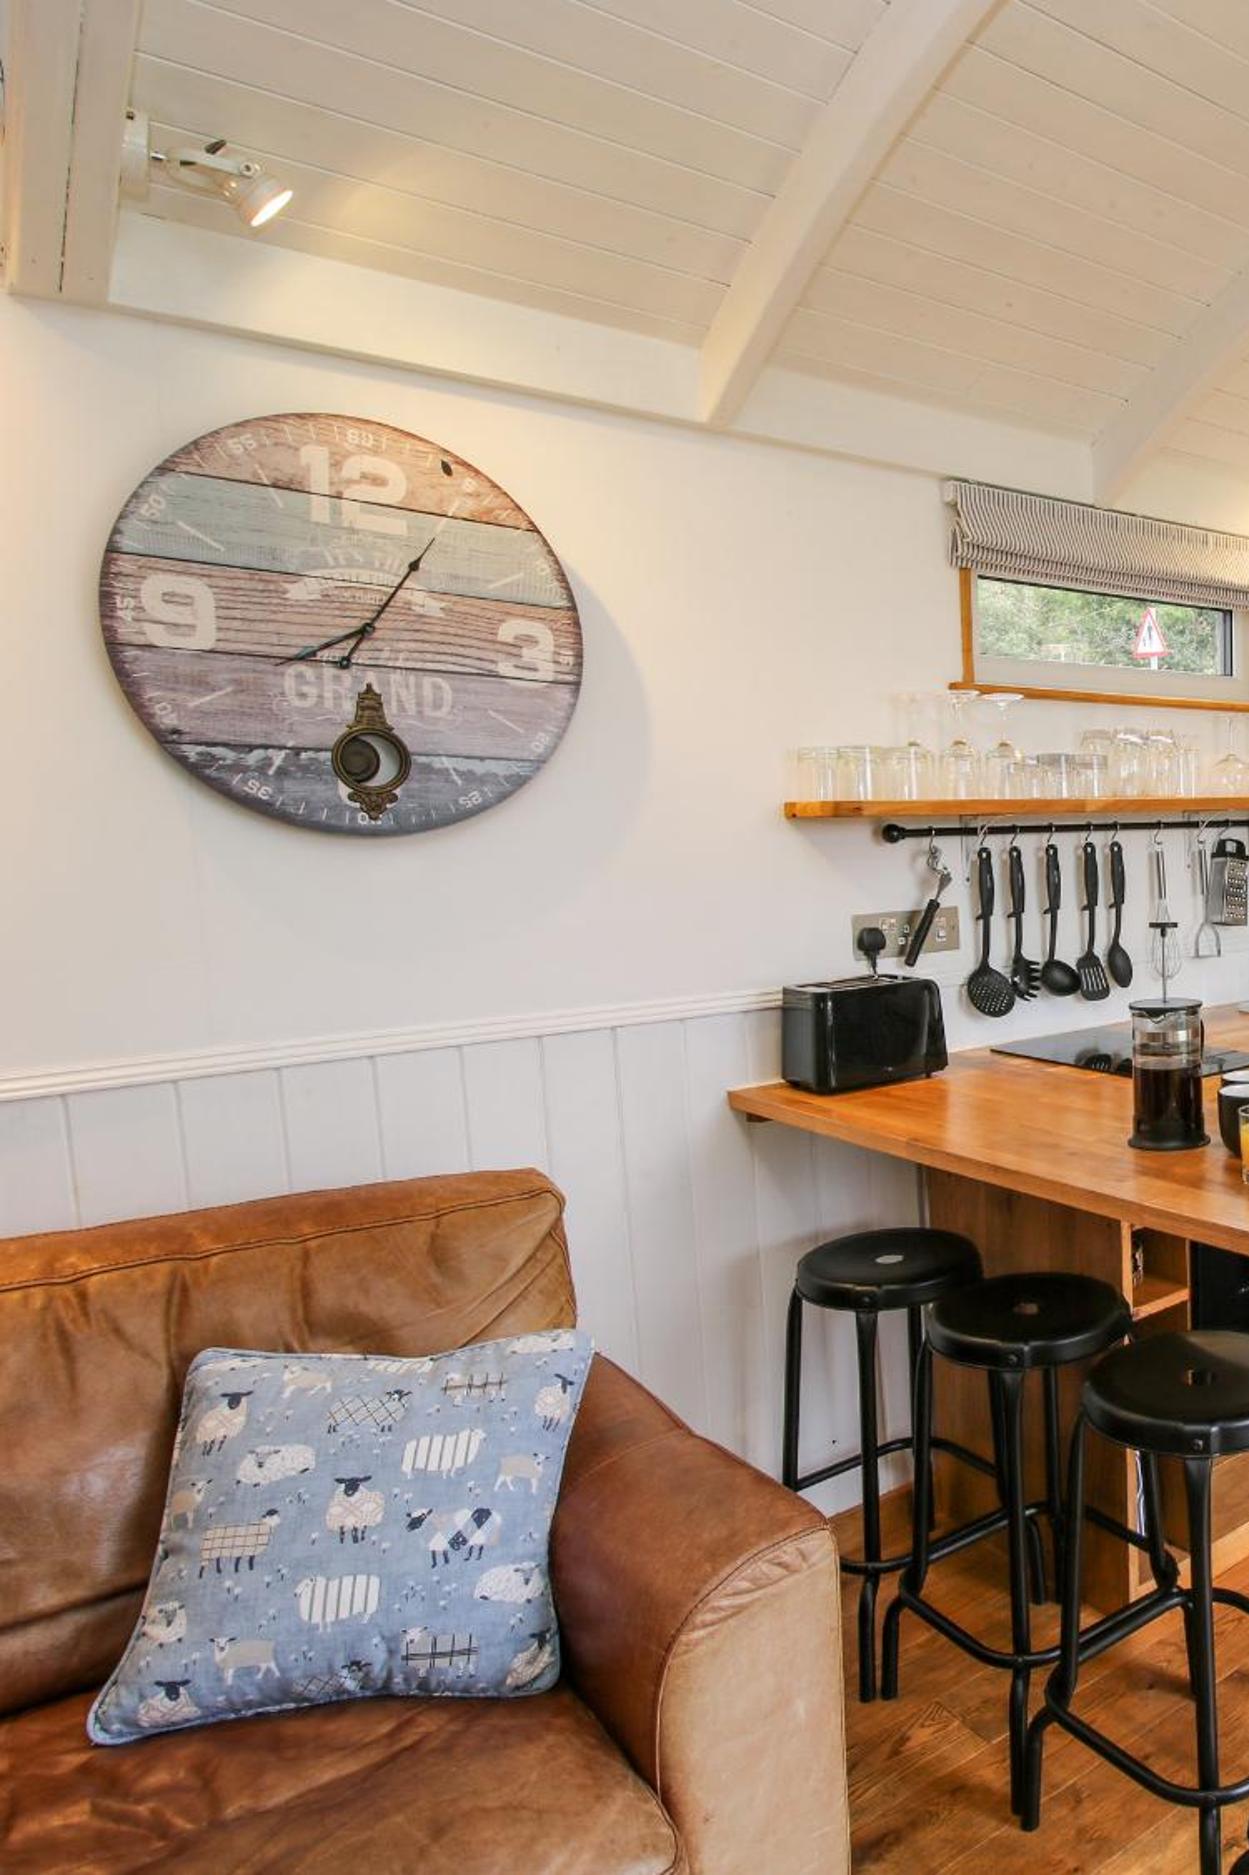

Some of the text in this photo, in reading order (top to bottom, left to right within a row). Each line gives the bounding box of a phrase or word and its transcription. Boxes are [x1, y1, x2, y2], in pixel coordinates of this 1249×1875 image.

[227, 434, 257, 453] 55
[300, 444, 408, 536] 12
[139, 494, 166, 518] 50
[140, 574, 216, 650] 9
[497, 619, 555, 689] 3
[243, 778, 273, 800] 35
[458, 790, 483, 809] 25
